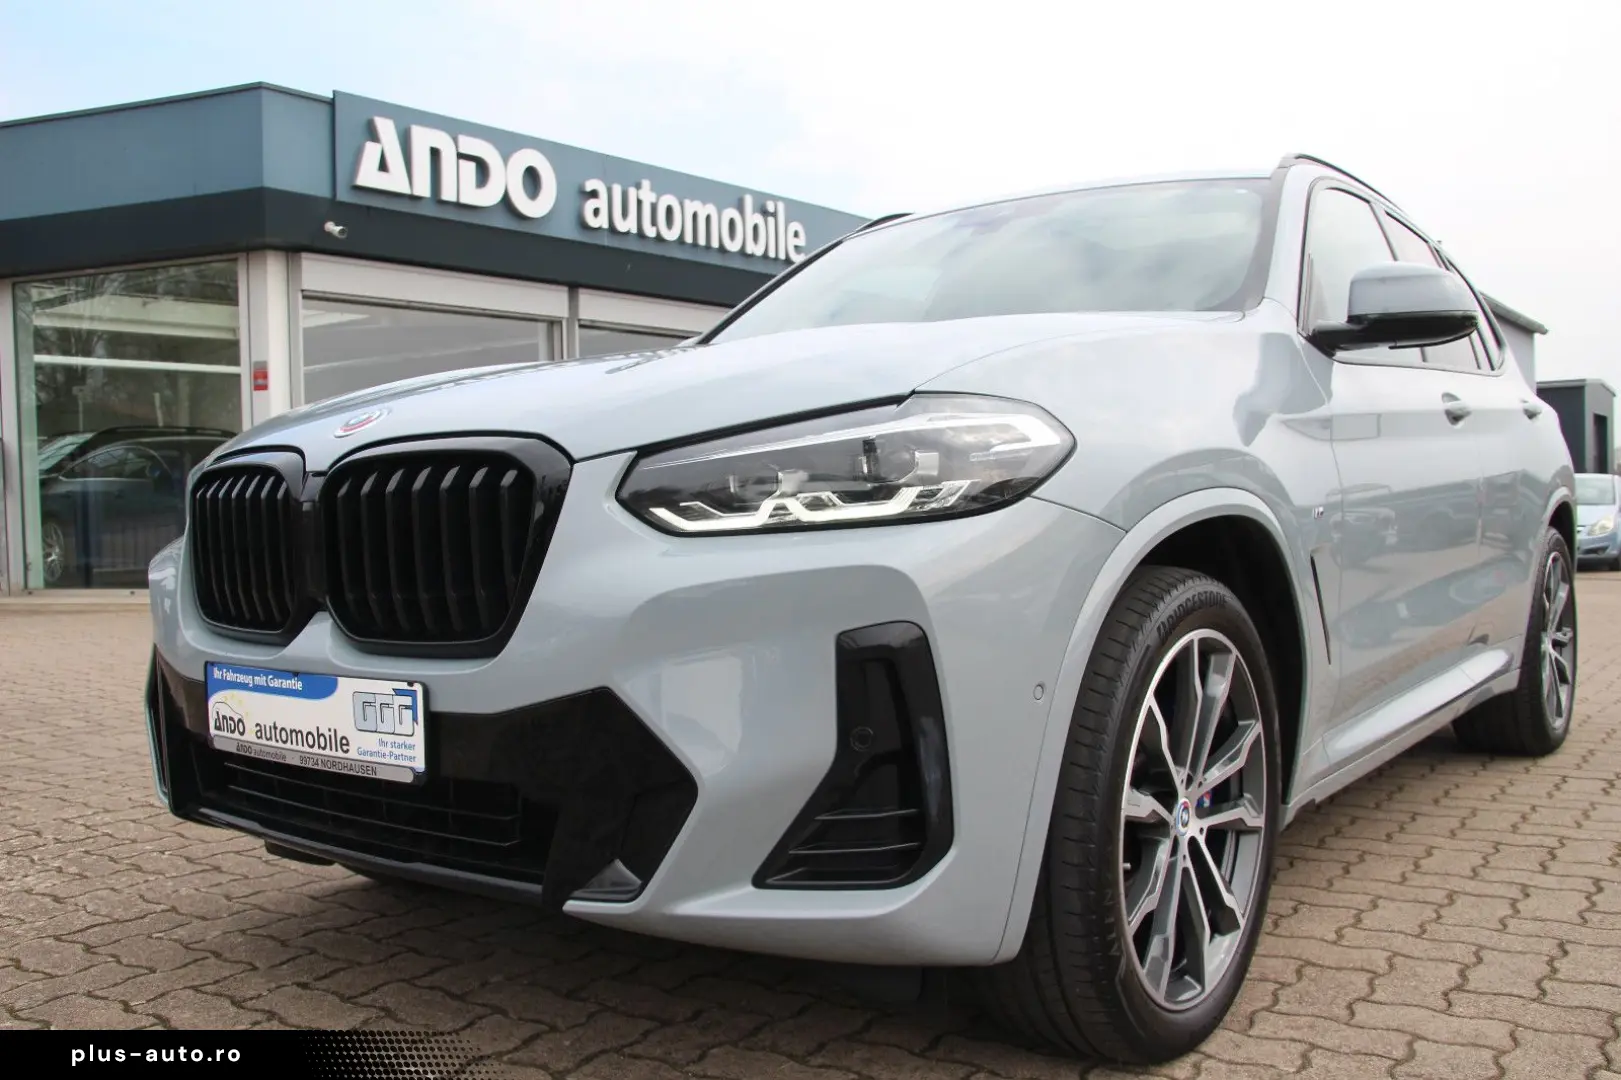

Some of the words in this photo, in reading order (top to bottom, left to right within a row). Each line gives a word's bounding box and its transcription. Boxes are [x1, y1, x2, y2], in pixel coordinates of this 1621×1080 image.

[353, 116, 557, 219] ANDO
[582, 178, 806, 263] automobile
[213, 667, 222, 680] Ihr
[223, 669, 253, 687] Fahrzeug
[254, 674, 267, 686] mit
[268, 675, 303, 690] Garantie
[214, 711, 246, 736] ANDO
[255, 722, 350, 754] automobile
[378, 738, 389, 748] Ihr
[390, 740, 416, 751] starker
[253, 747, 287, 762] automobile
[299, 756, 320, 767] 99734
[320, 758, 377, 777] NORDHAUSEN
[357, 747, 417, 763] Garantie-Partner
